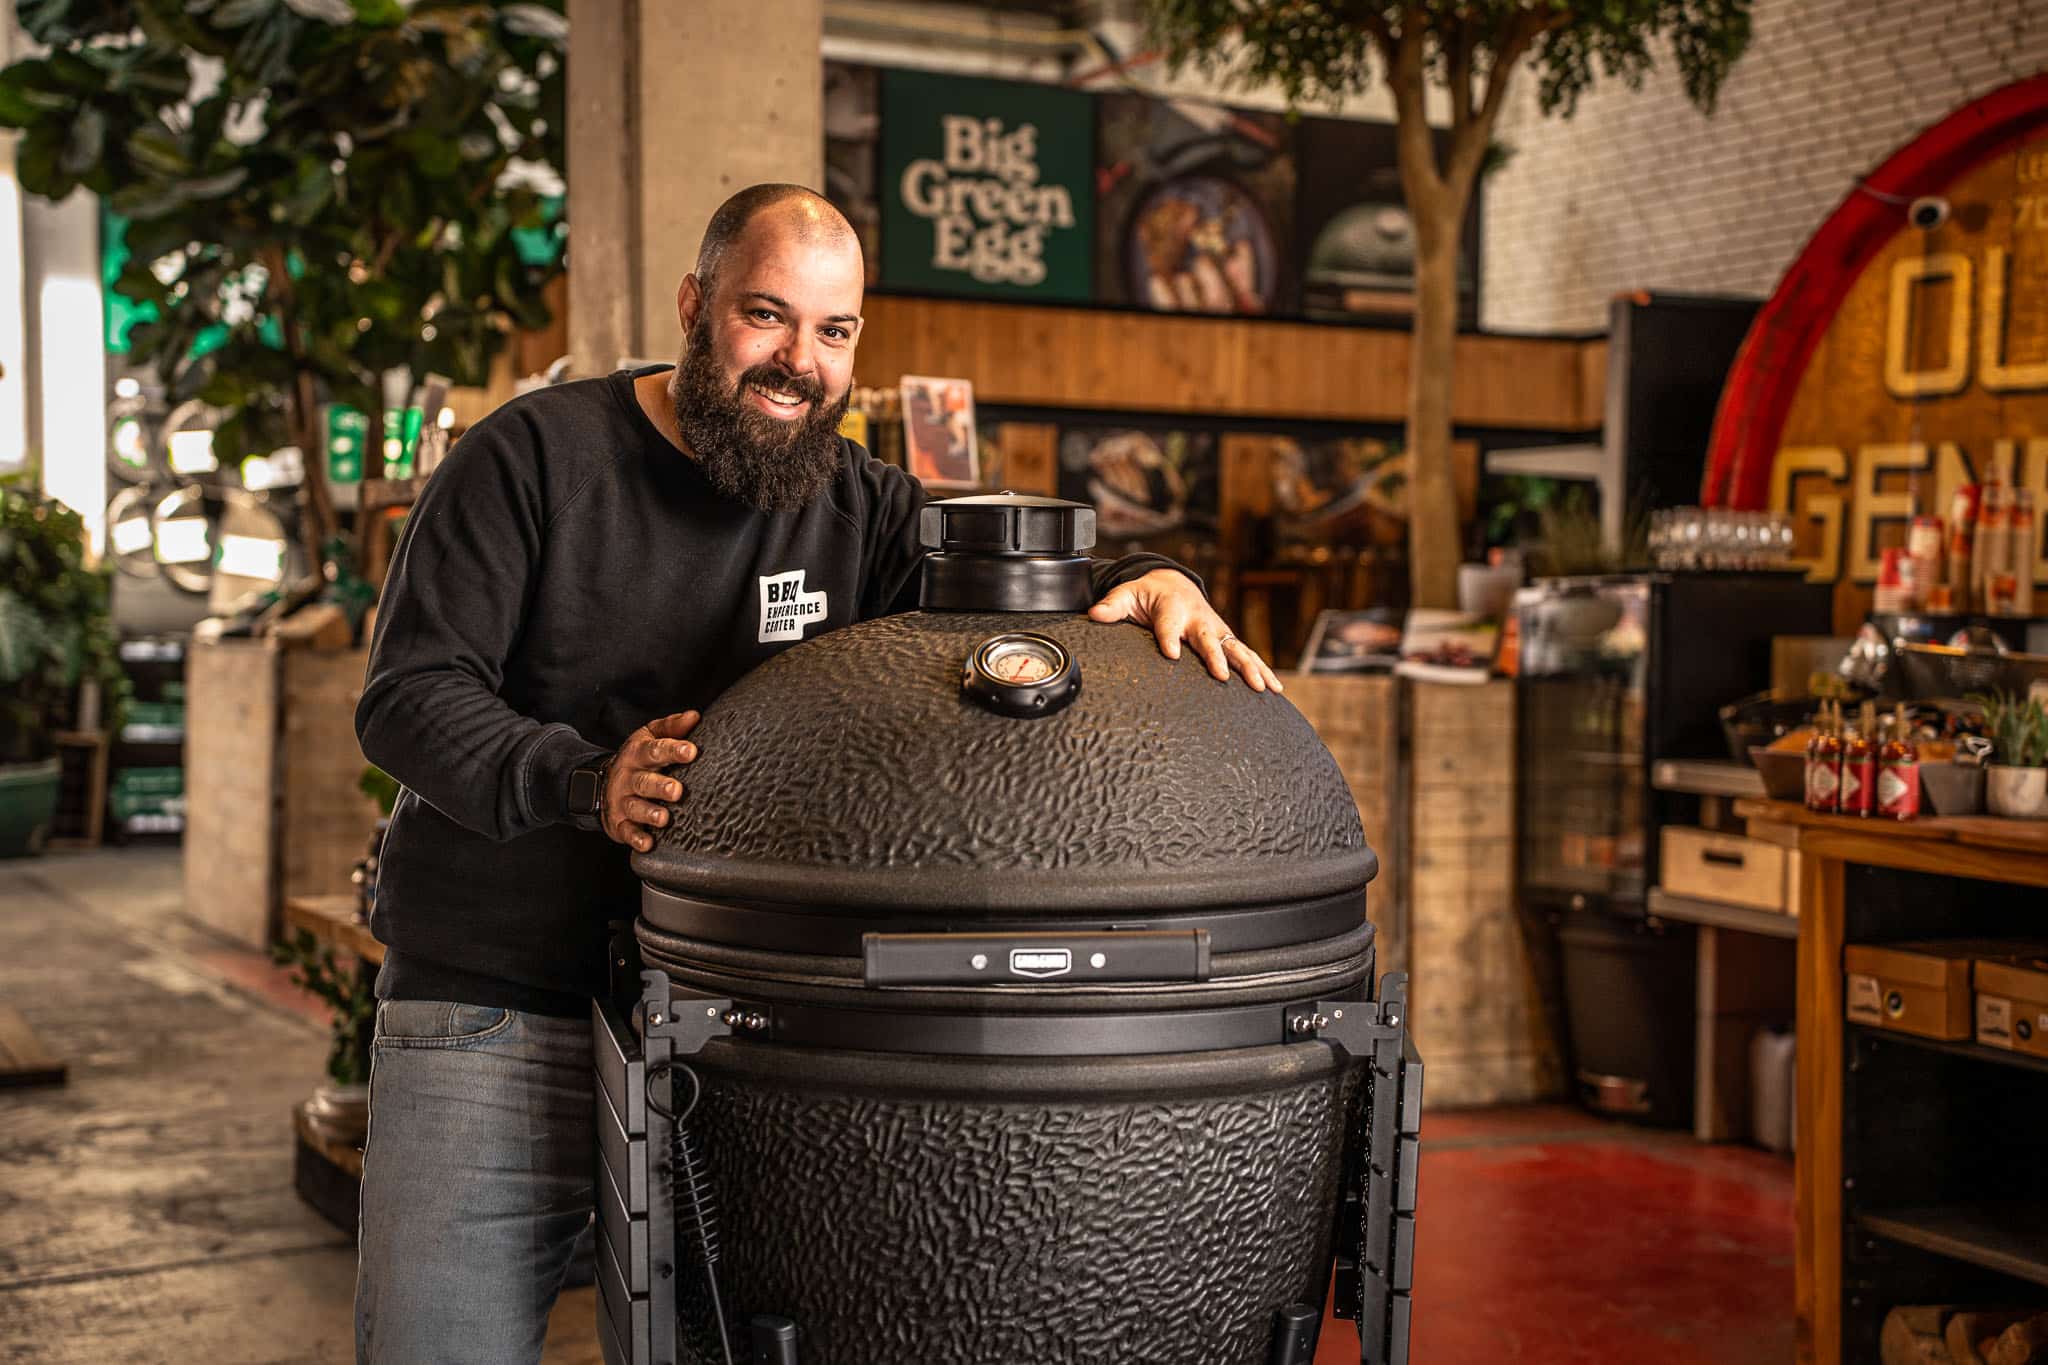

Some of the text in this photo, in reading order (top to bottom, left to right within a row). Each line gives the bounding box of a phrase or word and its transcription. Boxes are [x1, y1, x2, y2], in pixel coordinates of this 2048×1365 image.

[943, 115, 1039, 183] Big
[901, 159, 1075, 228] Green
[932, 215, 1047, 285] Egg
[767, 580, 799, 603] BBQ
[767, 602, 820, 619] EXPERIENCE
[765, 619, 795, 633] CENTER
